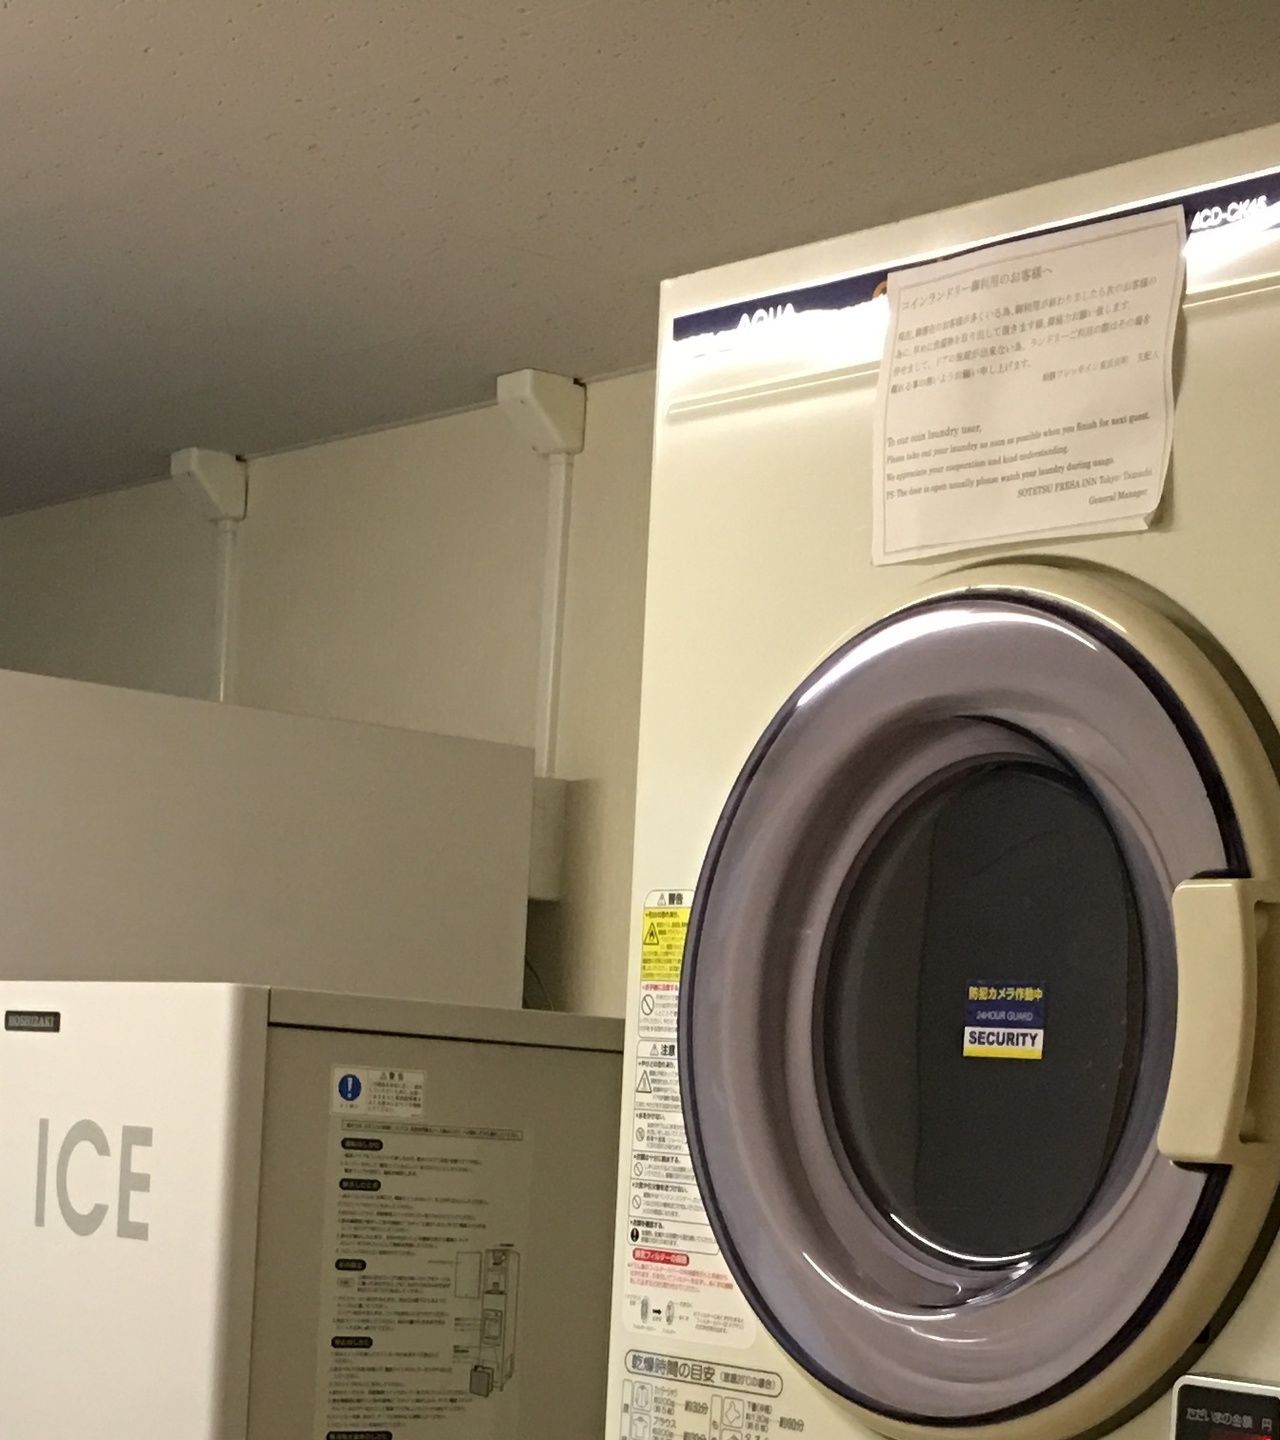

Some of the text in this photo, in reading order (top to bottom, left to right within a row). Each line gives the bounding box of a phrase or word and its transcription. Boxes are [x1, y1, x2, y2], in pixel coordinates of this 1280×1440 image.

[8, 1014, 55, 1028] HOSHIZAKI
[968, 1031, 1038, 1048] SECURITY
[661, 1044, 676, 1056] 注意
[35, 1118, 153, 1242] ICE
[632, 1354, 716, 1383] 乾燥時間の目安
[1185, 1408, 1273, 1431] ただいまの金額 円
